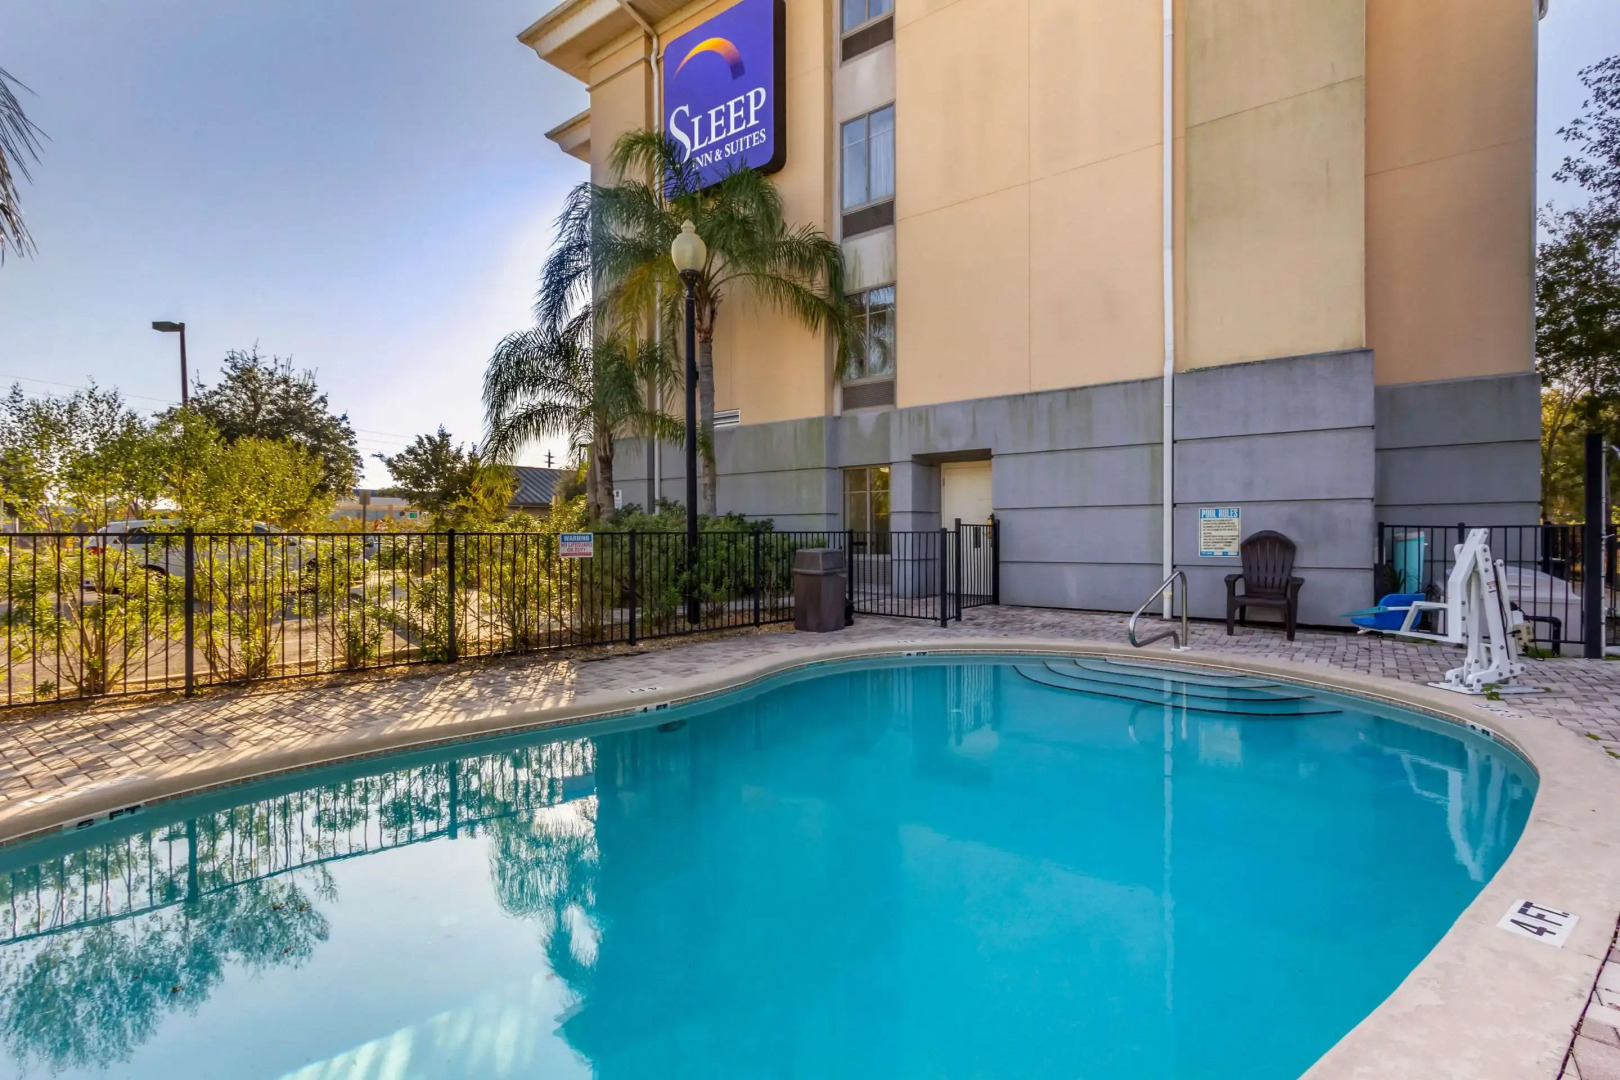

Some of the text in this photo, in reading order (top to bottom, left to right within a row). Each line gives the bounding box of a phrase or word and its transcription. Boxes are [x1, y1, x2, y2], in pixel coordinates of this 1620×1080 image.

[669, 87, 767, 164] SLEEP
[714, 148, 723, 162] &
[724, 128, 767, 158] SUITES
[1201, 507, 1239, 518] POOL RULES
[109, 804, 141, 821] FT
